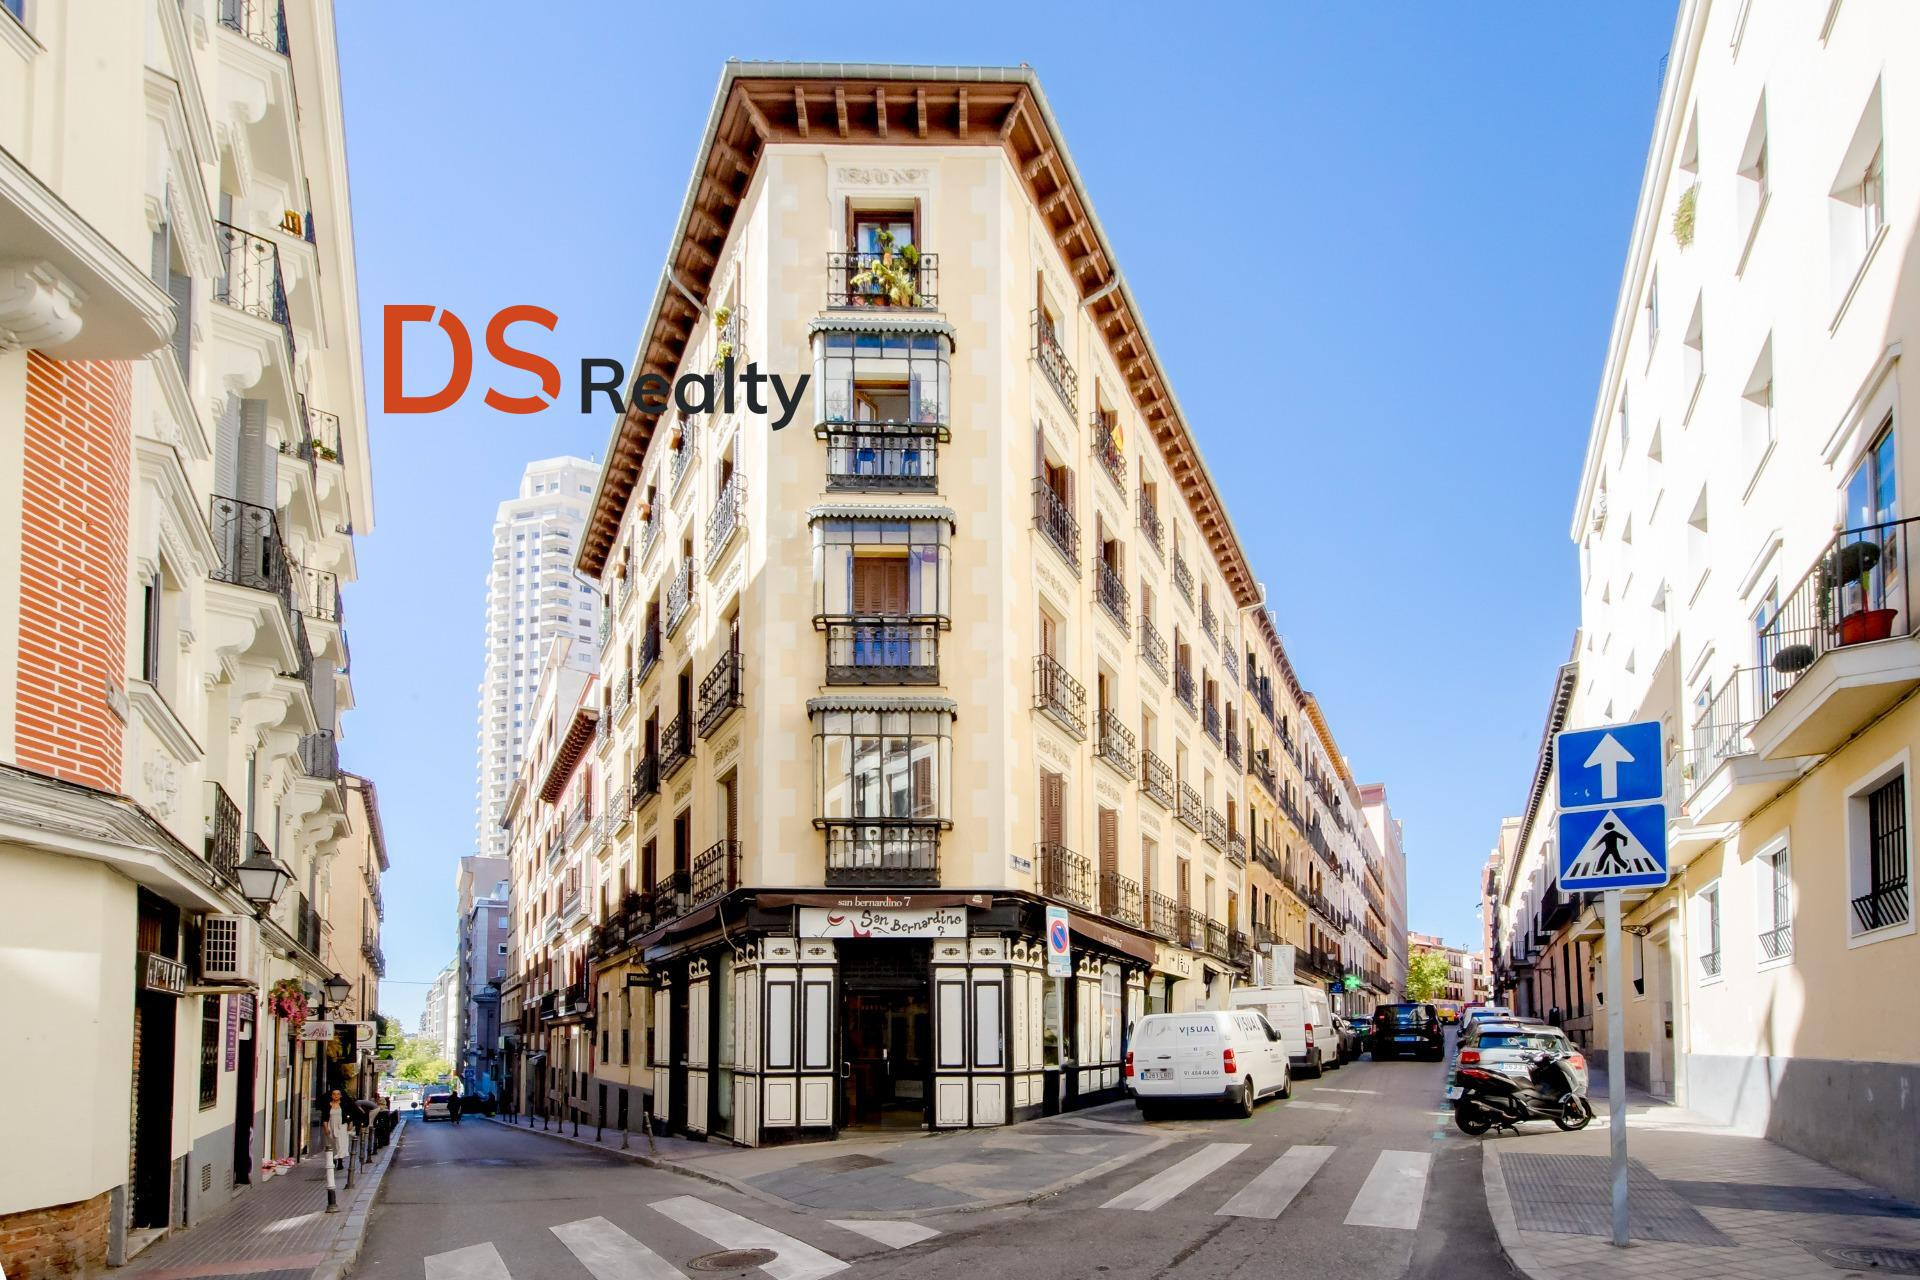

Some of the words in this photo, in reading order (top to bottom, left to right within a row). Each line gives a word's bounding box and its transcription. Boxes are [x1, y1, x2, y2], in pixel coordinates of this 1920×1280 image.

[855, 896, 902, 907] bernardino
[903, 897, 911, 907] 7
[861, 910, 889, 928] San
[890, 910, 962, 933] Bernardino
[1179, 1026, 1216, 1036] VISUAL
